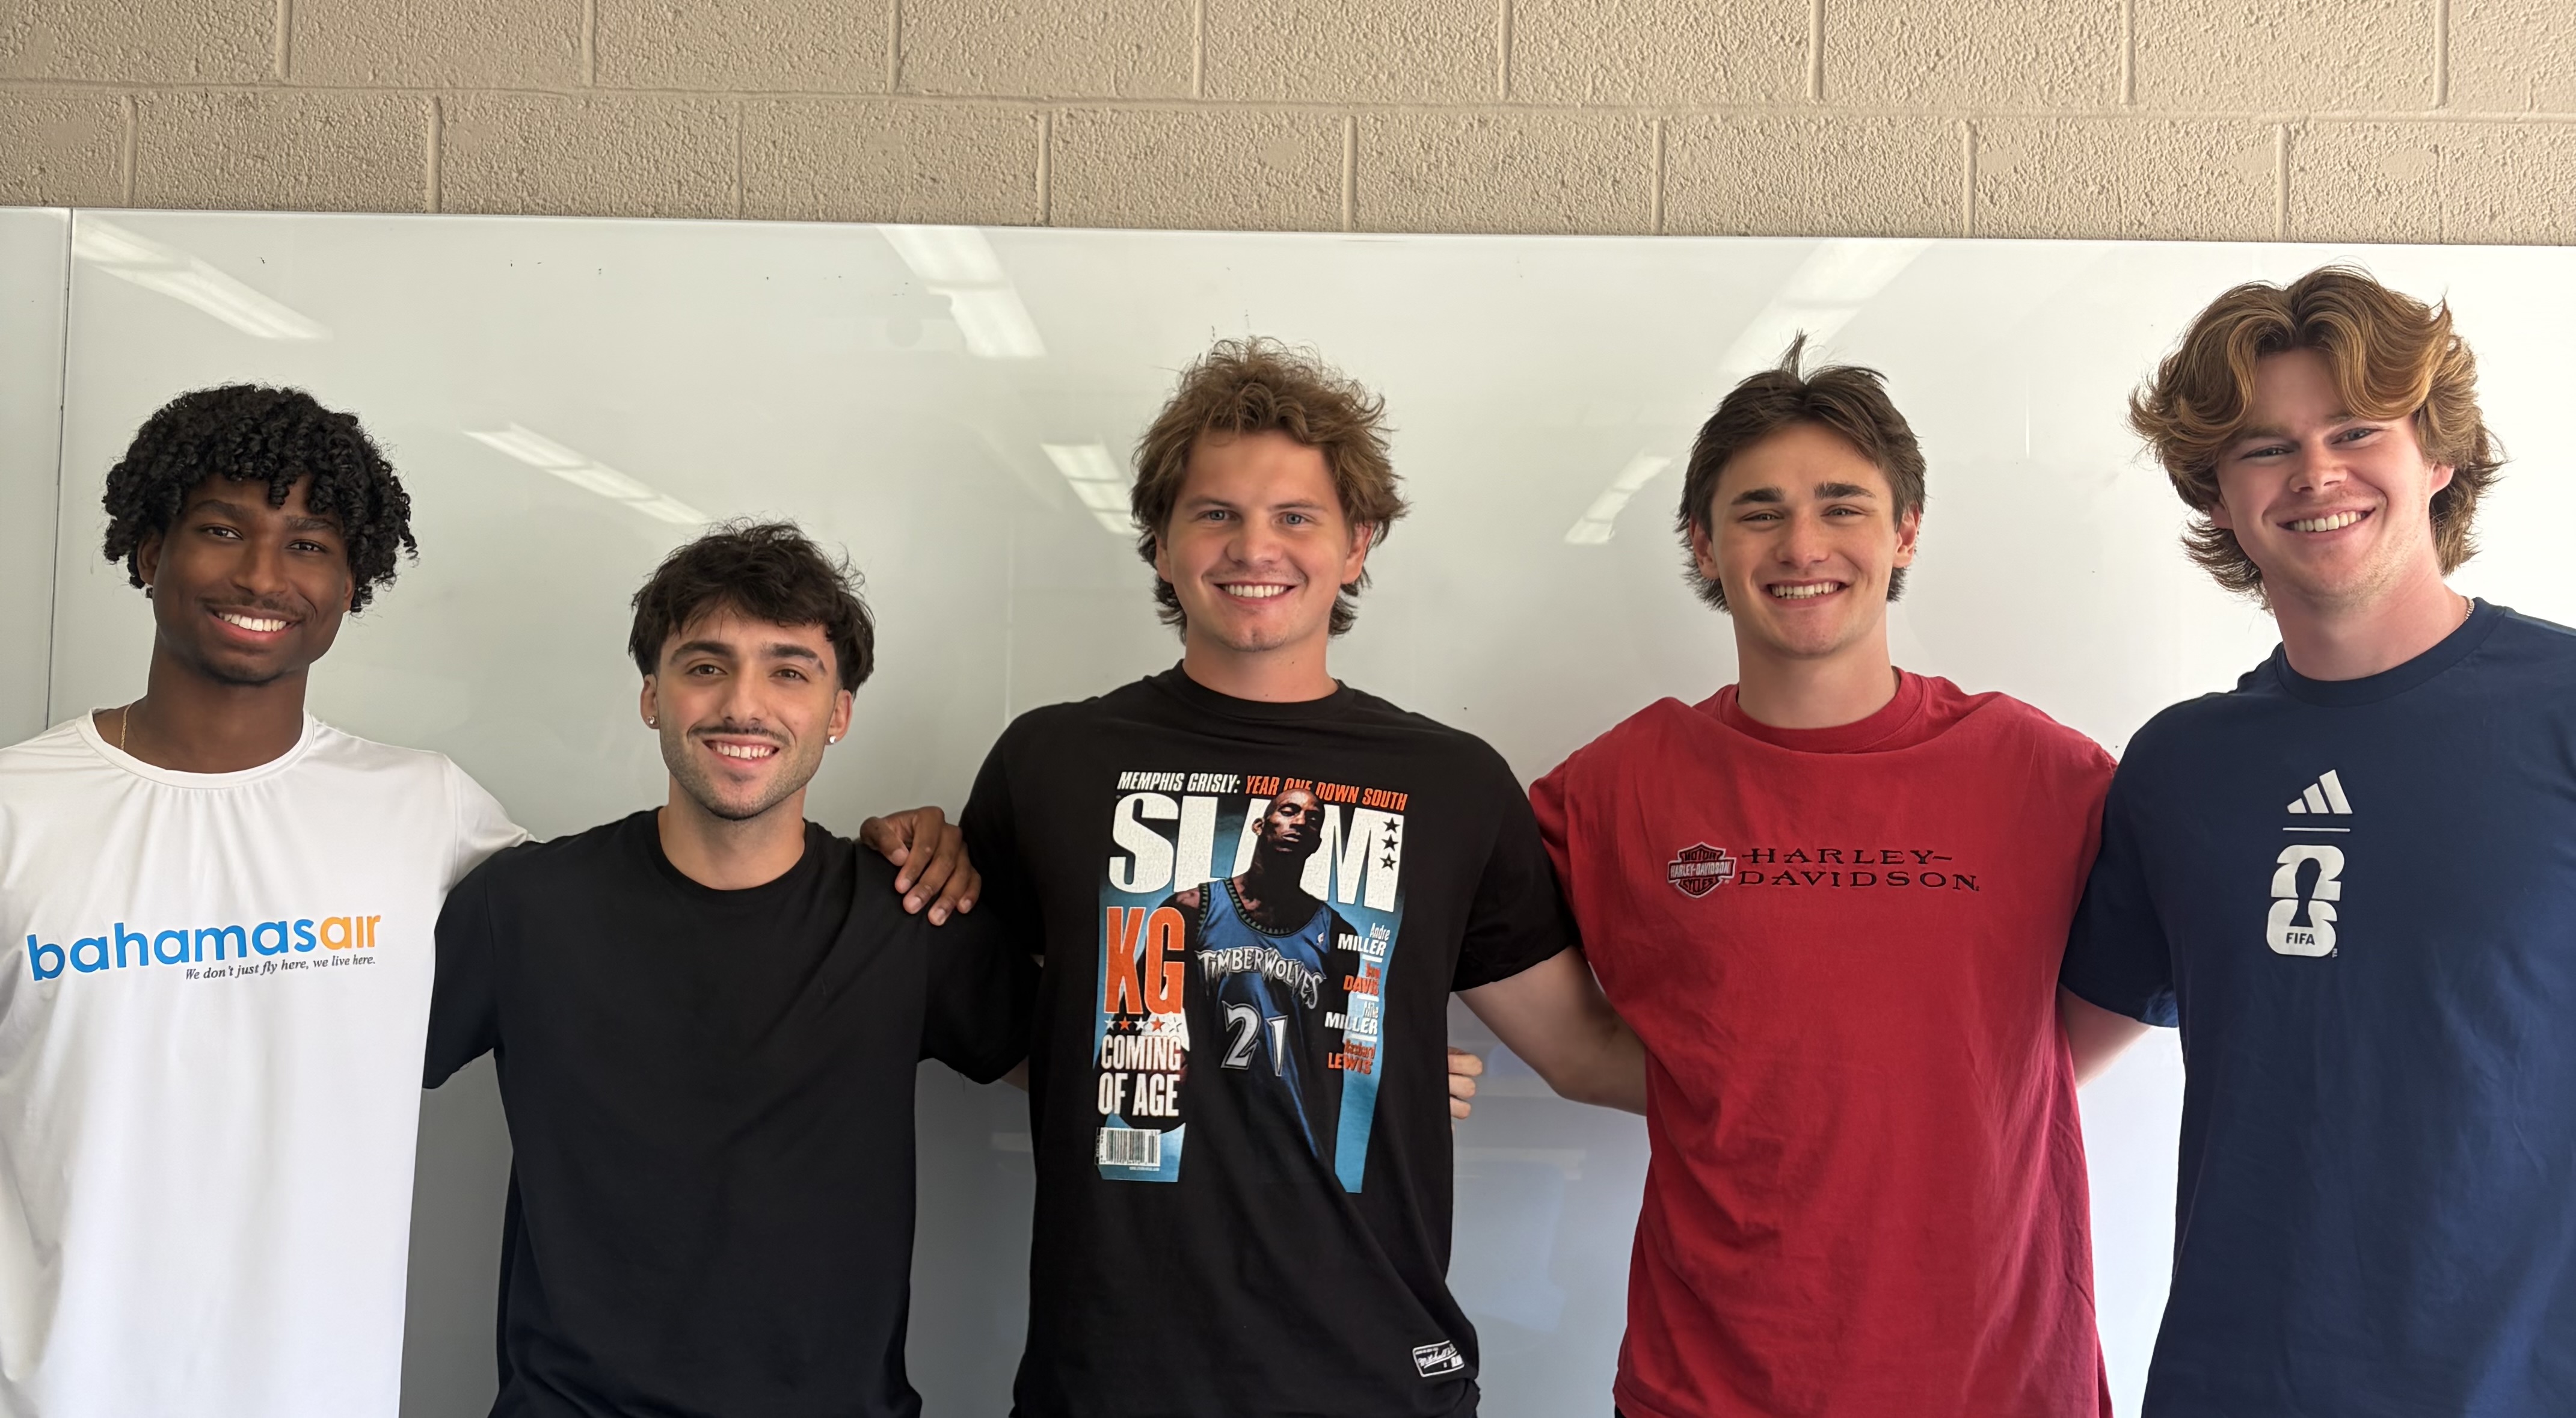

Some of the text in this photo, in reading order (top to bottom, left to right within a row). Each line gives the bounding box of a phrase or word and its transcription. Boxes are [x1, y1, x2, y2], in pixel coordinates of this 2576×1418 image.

[1117, 772, 1185, 791] MEMPHIS
[1187, 773, 1241, 793] GRISLY:
[1245, 775, 1280, 796] YEAR
[1315, 782, 1359, 803] DOWN
[1362, 788, 1408, 811] SOUTH
[1685, 849, 1718, 861] MOTOR
[1670, 861, 1732, 877] HARLEY-DAVIDSON
[1369, 922, 1391, 941] Andre
[2286, 932, 2316, 945] FIFA
[26, 915, 381, 981] bahamasair
[1338, 933, 1387, 956] MILLER
[186, 954, 376, 980] We don't just fly here, we live here.
[1104, 906, 1185, 1015] KG
[1324, 1011, 1379, 1035] MILLER
[1220, 1000, 1288, 1076] 21
[1101, 1034, 1181, 1070] COMING
[1328, 1052, 1372, 1075] LEWIS
[1098, 1072, 1181, 1116] OF AGE
